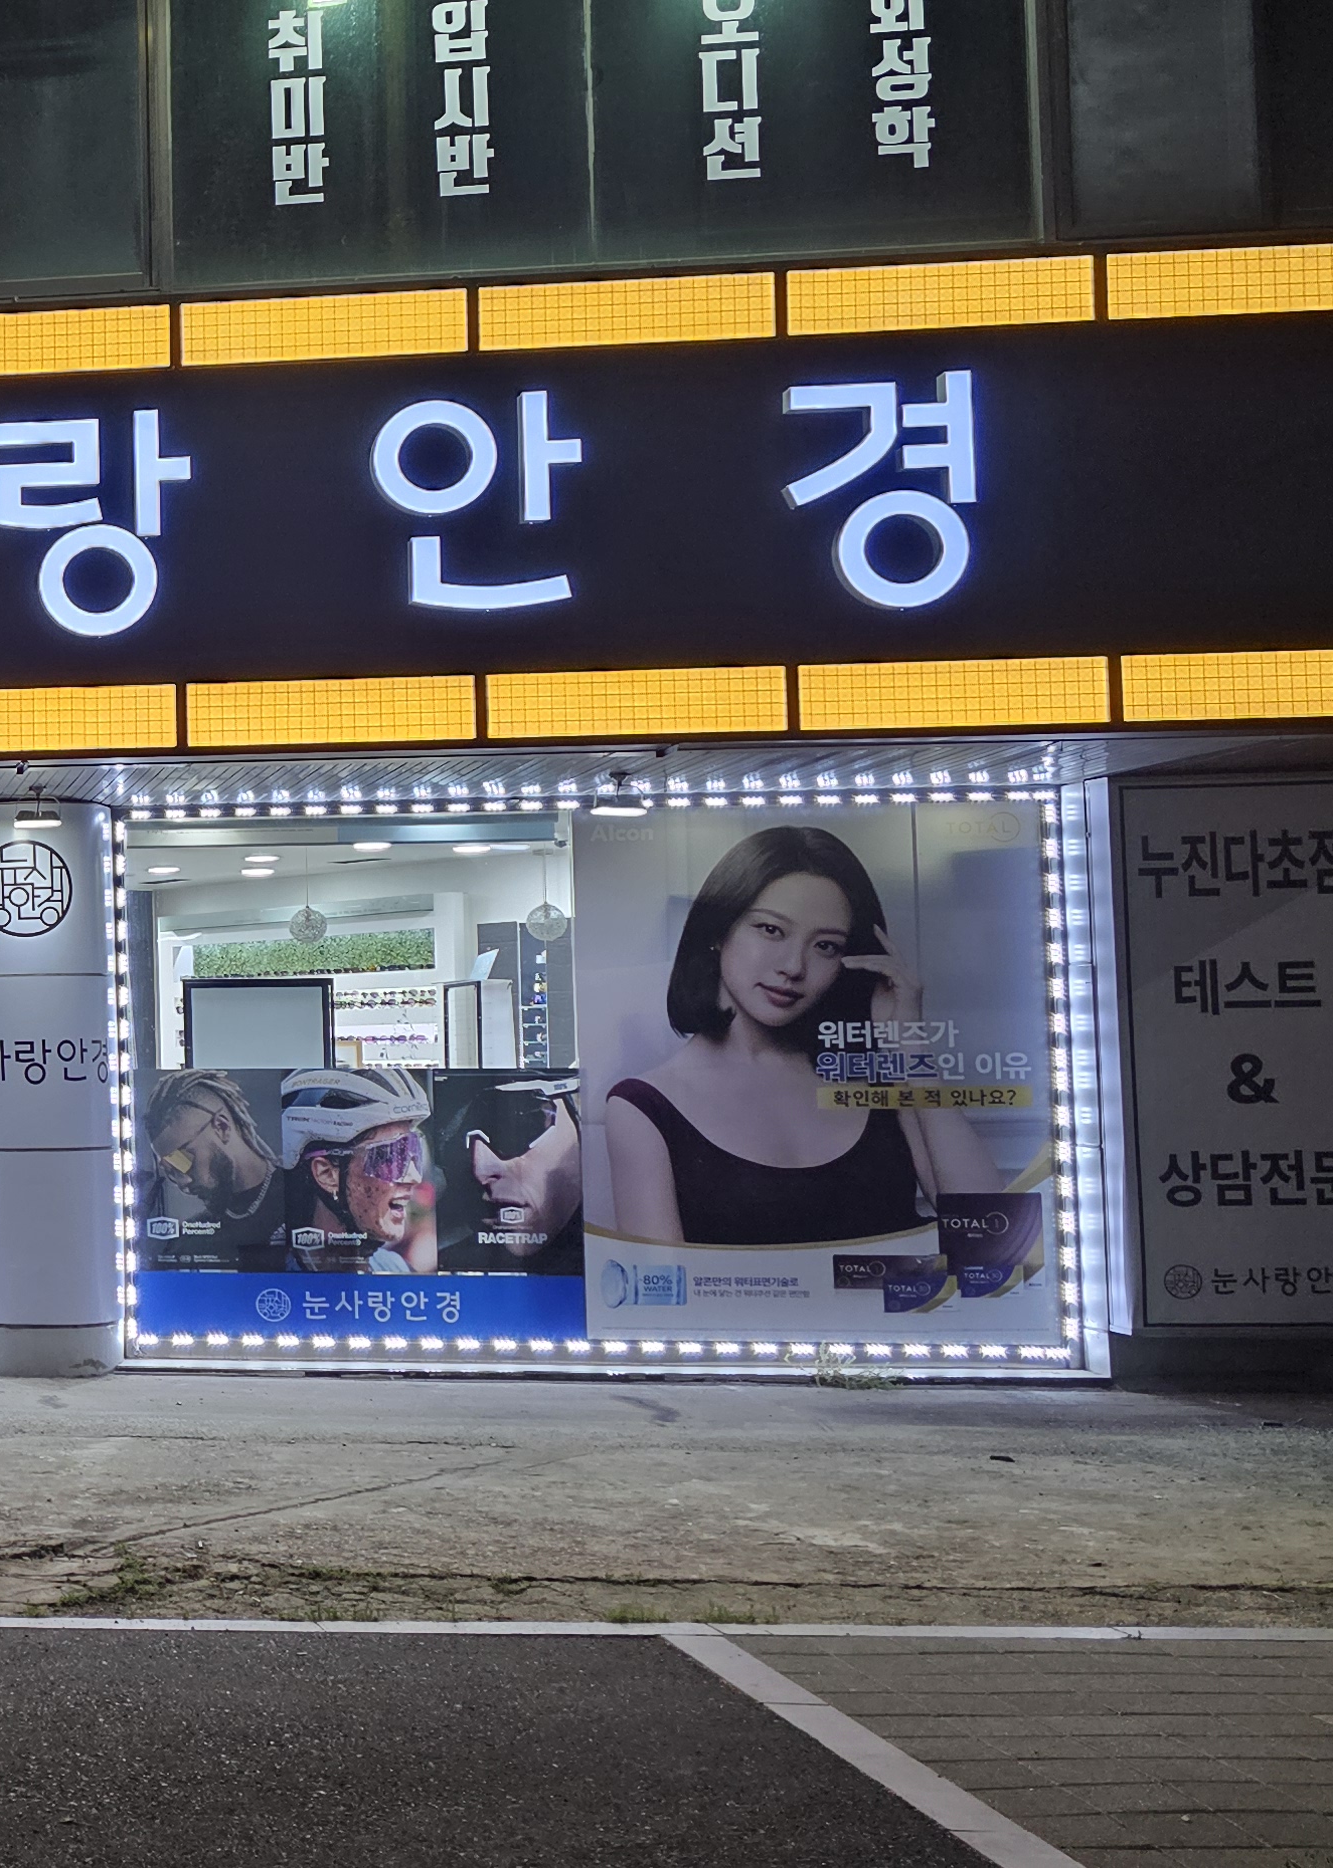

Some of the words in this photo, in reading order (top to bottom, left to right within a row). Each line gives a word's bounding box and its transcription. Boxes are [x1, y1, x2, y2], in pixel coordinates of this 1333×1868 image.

[432, 0, 495, 197] 입시반
[699, 0, 761, 182] 오디션
[267, 10, 330, 206] 취미반
[590, 824, 654, 842] Alcon
[1173, 957, 1322, 1016] 테스트
[817, 1019, 960, 1049] 워터렌즈가
[815, 1051, 965, 1084] 워터렌즈인
[975, 1052, 1033, 1081] 이유
[1226, 1053, 1280, 1105] &
[833, 1089, 890, 1107] 확인해
[899, 1089, 915, 1107] 본
[930, 1088, 945, 1107] 적
[950, 1087, 1017, 1107] 있나요?
[151, 1221, 176, 1235] 100%
[942, 1218, 988, 1229] TOTAL
[296, 1232, 321, 1245] 100%
[477, 1231, 548, 1244] RACETRAP
[839, 1264, 871, 1273] TOTAL
[643, 1285, 673, 1293] WATER
[888, 1284, 917, 1293] TOTAL
[302, 1289, 462, 1324] 눈사랑안경
